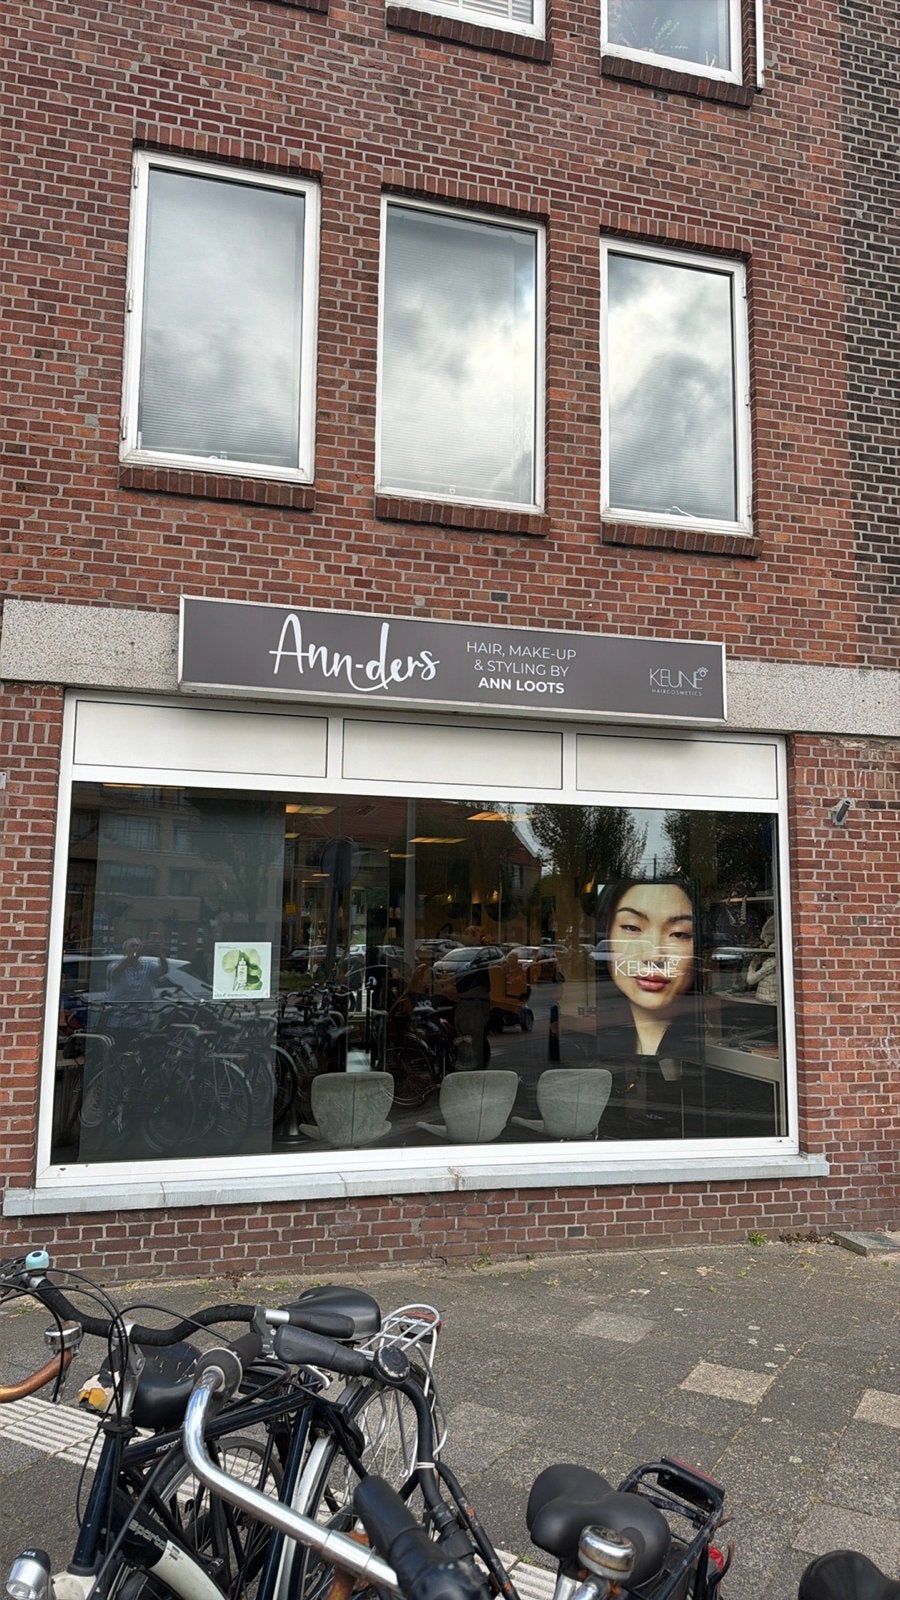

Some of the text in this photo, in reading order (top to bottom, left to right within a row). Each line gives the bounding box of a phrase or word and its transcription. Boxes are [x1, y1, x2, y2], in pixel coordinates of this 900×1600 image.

[268, 613, 441, 692] Ann-ders
[466, 641, 577, 661] HAIR, MAKE-UP
[473, 659, 569, 677] & STYLING BY
[478, 677, 565, 694] ANN LOOTS
[649, 667, 704, 690] KEUNE
[614, 959, 678, 978] KEUNE
